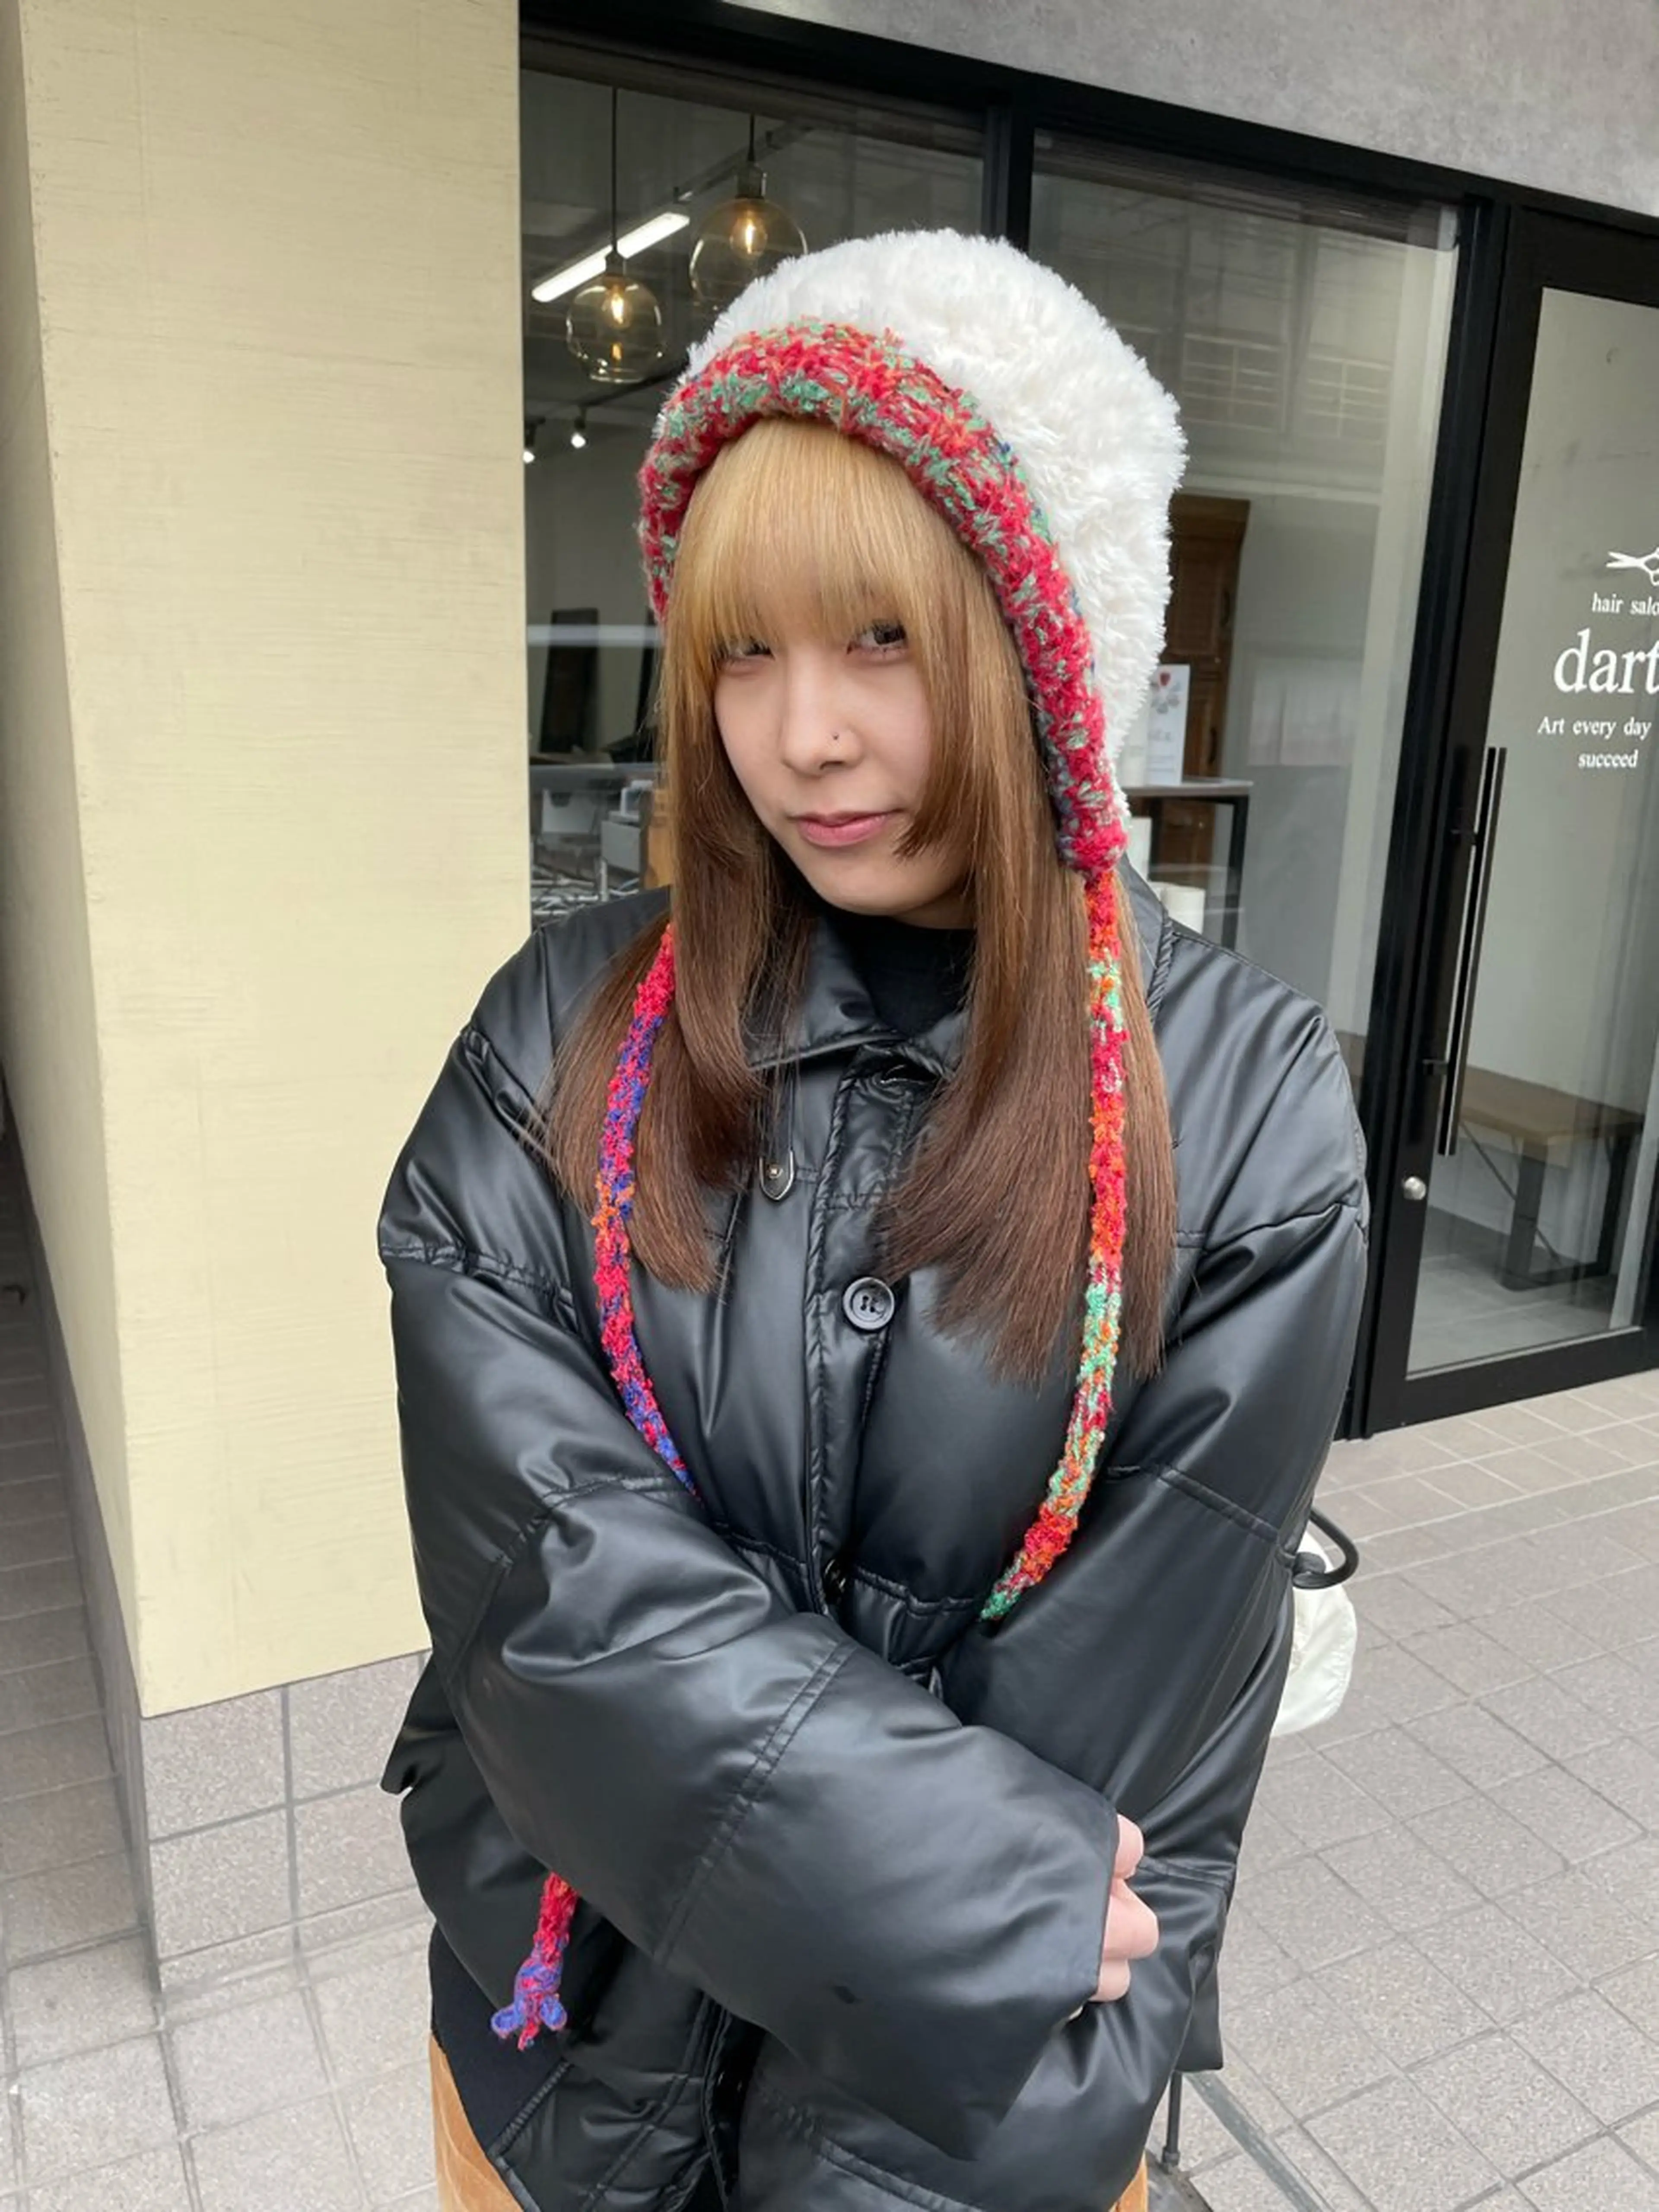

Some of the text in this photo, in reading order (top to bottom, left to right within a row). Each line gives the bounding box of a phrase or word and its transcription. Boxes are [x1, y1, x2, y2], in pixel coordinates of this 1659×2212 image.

[1592, 591, 1623, 613] hair
[1537, 716, 1652, 741] Art every day
[1578, 749, 1639, 769] succeed
